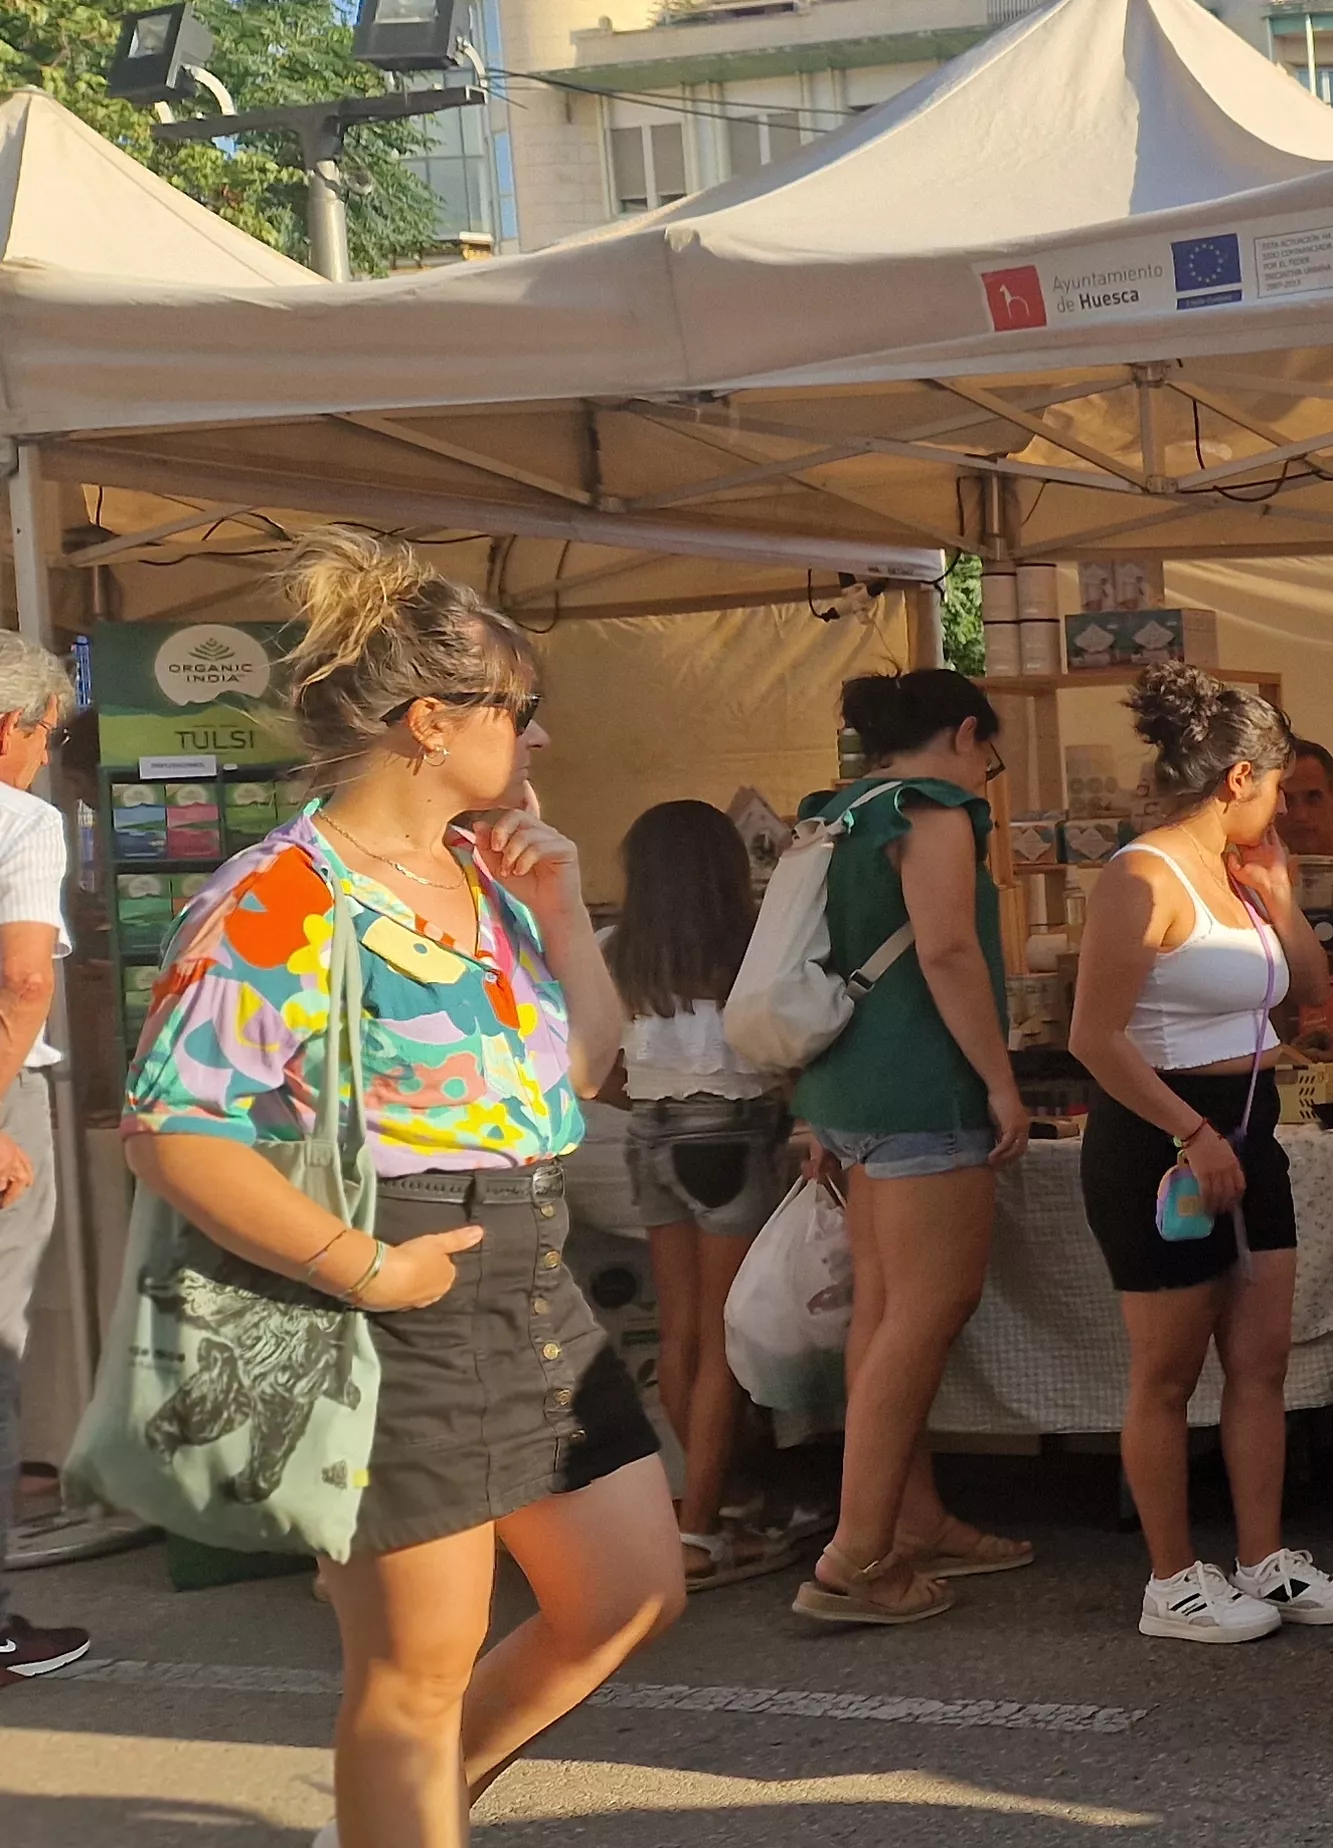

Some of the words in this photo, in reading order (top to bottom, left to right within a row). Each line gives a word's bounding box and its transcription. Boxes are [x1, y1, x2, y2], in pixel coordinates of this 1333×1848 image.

[1053, 264, 1163, 295] Ayuntamiento
[1057, 296, 1075, 313] de
[1079, 288, 1140, 311] Huesca
[168, 663, 254, 674] ORGANIC
[187, 673, 240, 683] INDIA
[174, 730, 254, 749] TULSI
